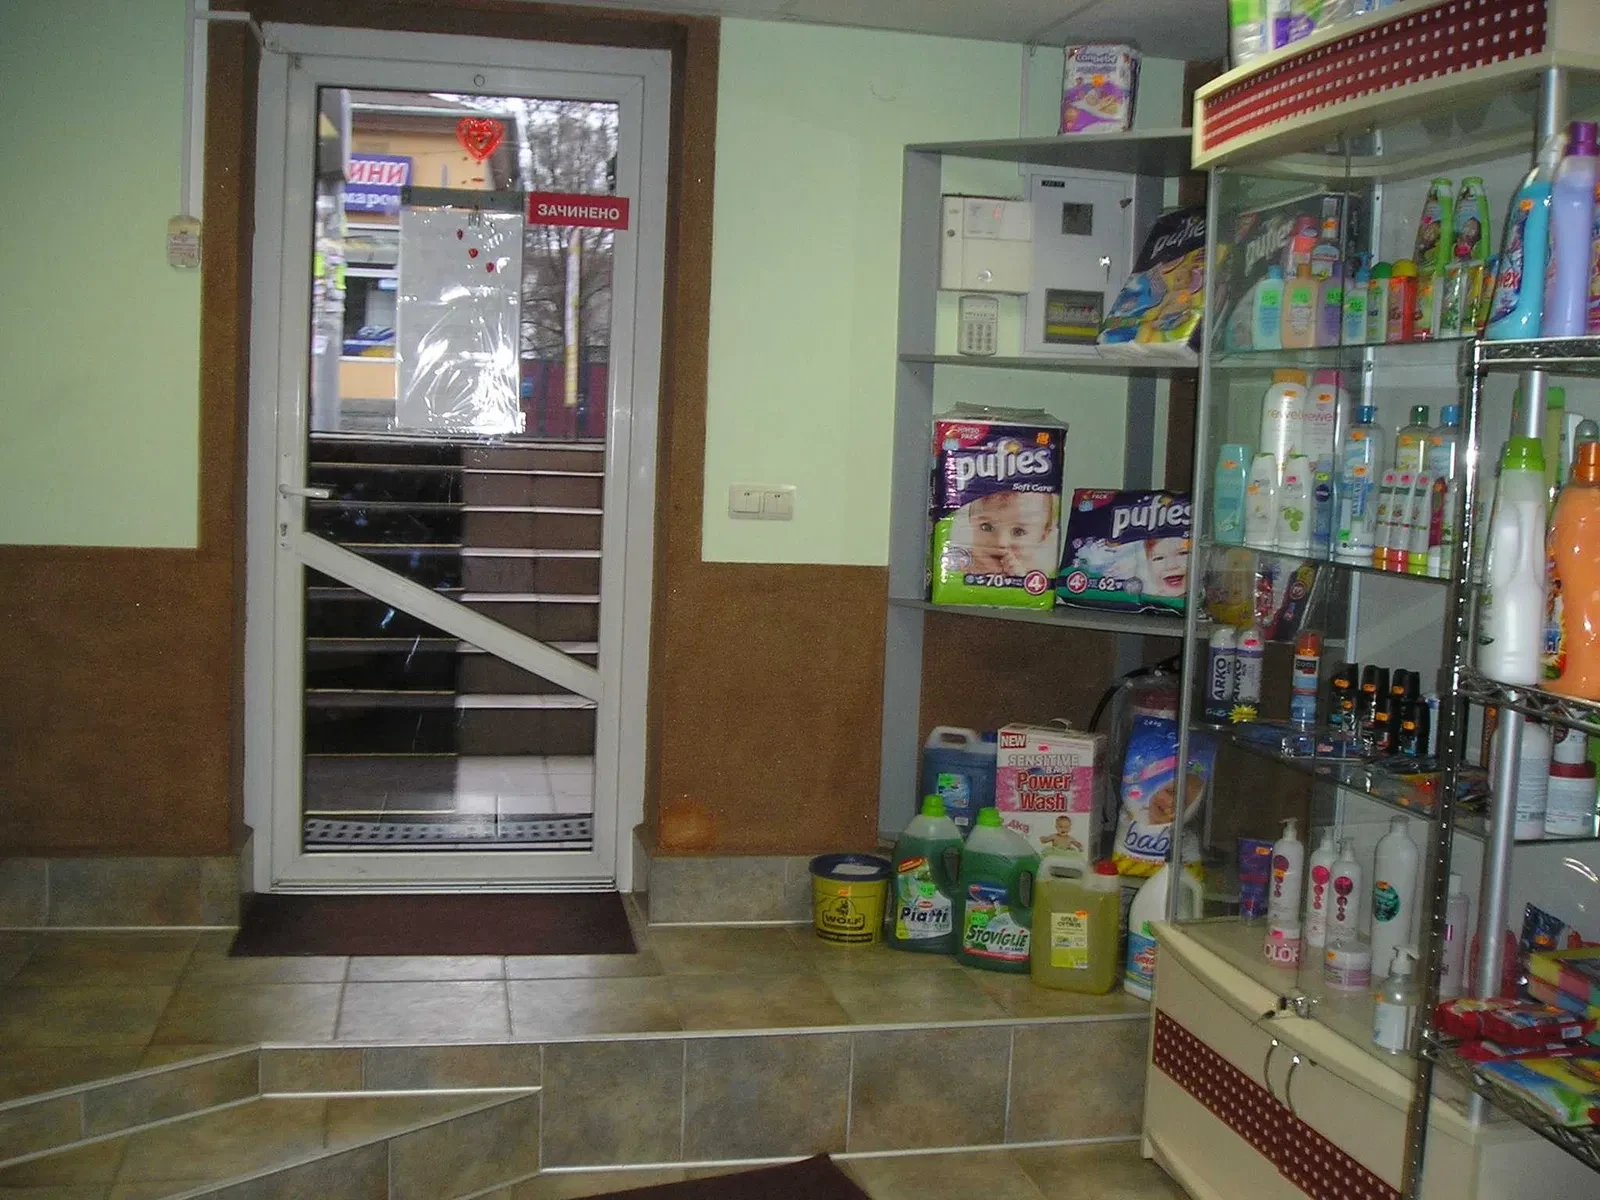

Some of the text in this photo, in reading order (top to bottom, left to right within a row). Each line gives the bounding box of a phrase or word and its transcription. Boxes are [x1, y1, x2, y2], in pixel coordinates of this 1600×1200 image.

[537, 203, 620, 221] ЗАЧИНЕНО
[1012, 483, 1030, 492] Soft
[986, 574, 1004, 588] 70
[1098, 578, 1116, 591] 62
[1213, 657, 1227, 700] ARKO
[1001, 735, 1025, 748] NEW
[1008, 754, 1080, 767] SENSITIVE
[1016, 771, 1073, 791] Power
[1020, 792, 1068, 811] Wash
[900, 906, 949, 923] Piatti
